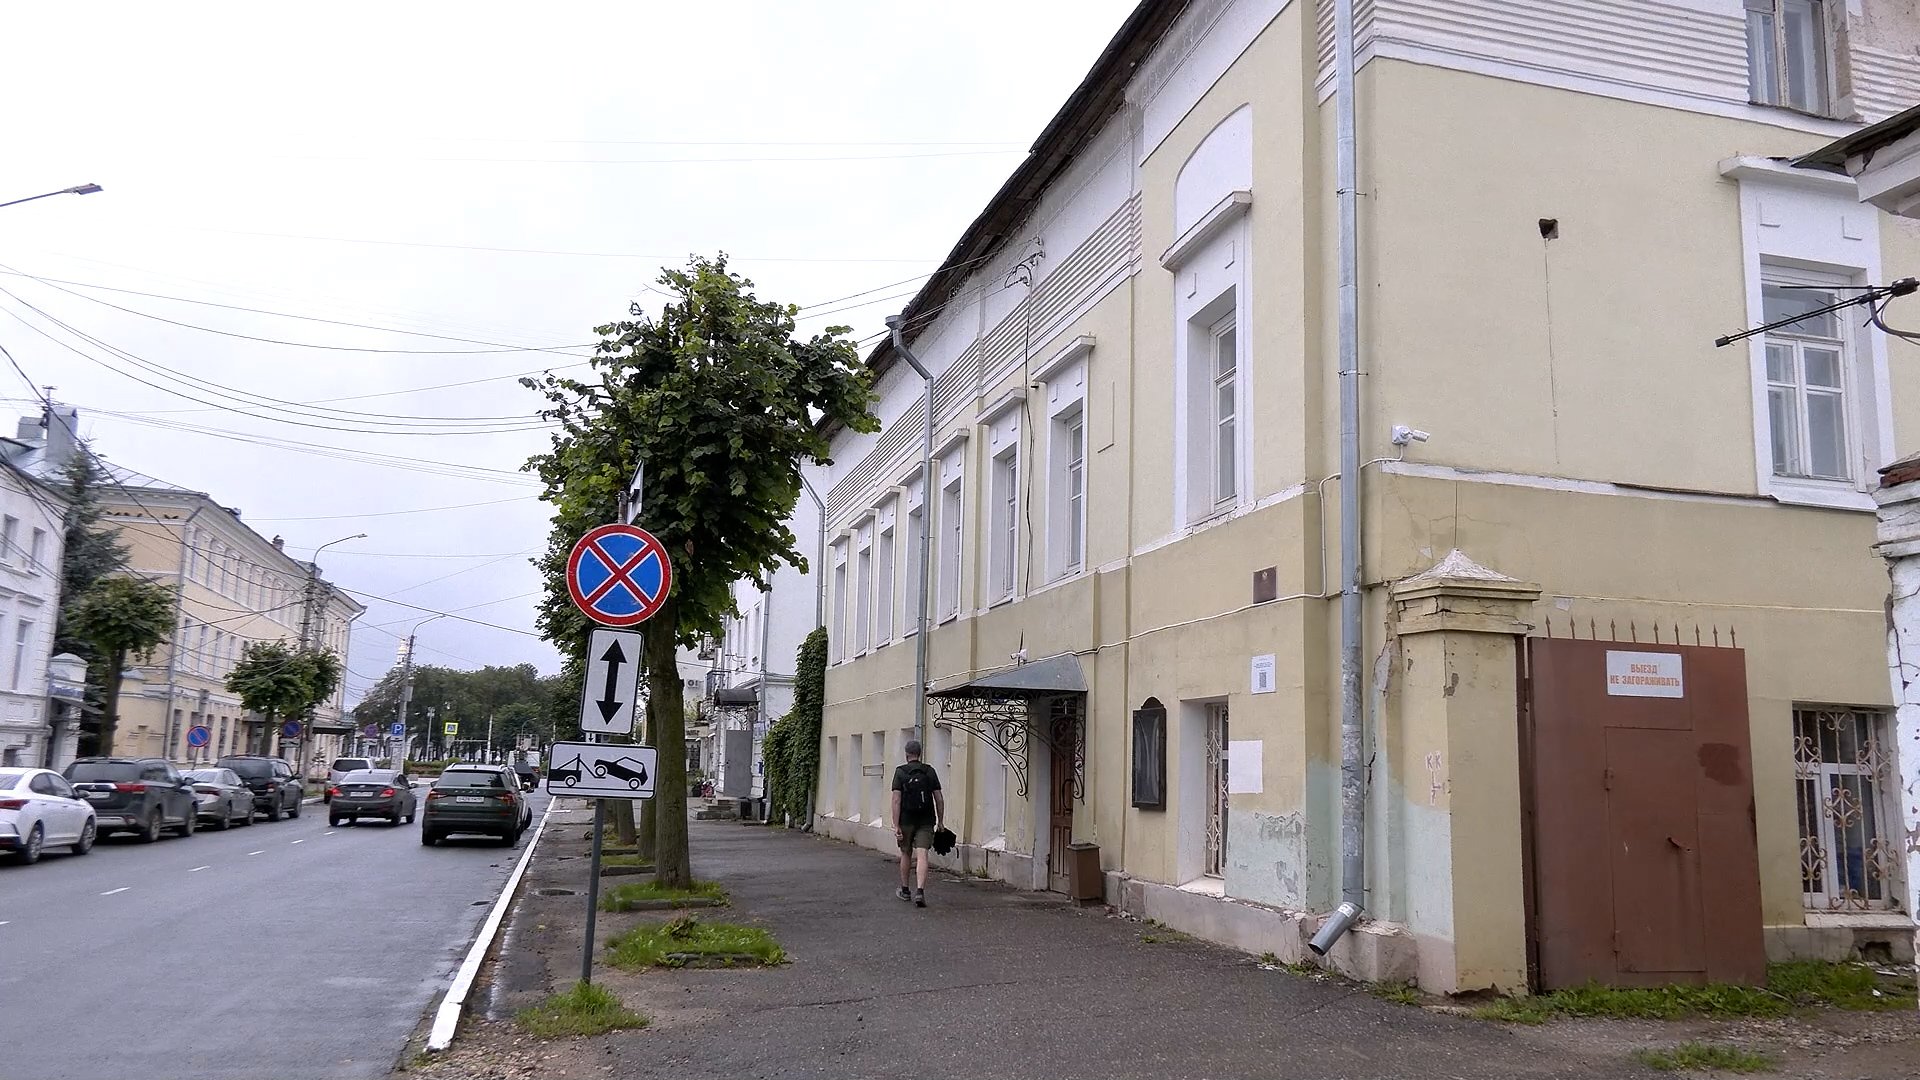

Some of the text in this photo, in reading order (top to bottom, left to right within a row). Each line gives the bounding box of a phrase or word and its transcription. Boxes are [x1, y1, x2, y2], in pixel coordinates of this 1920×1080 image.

[1631, 664, 1657, 674] ВЫЕЗД
[1610, 675, 1680, 687] НЕ ЗАГОРАЖИВАТЬ
[394, 724, 403, 734] P
